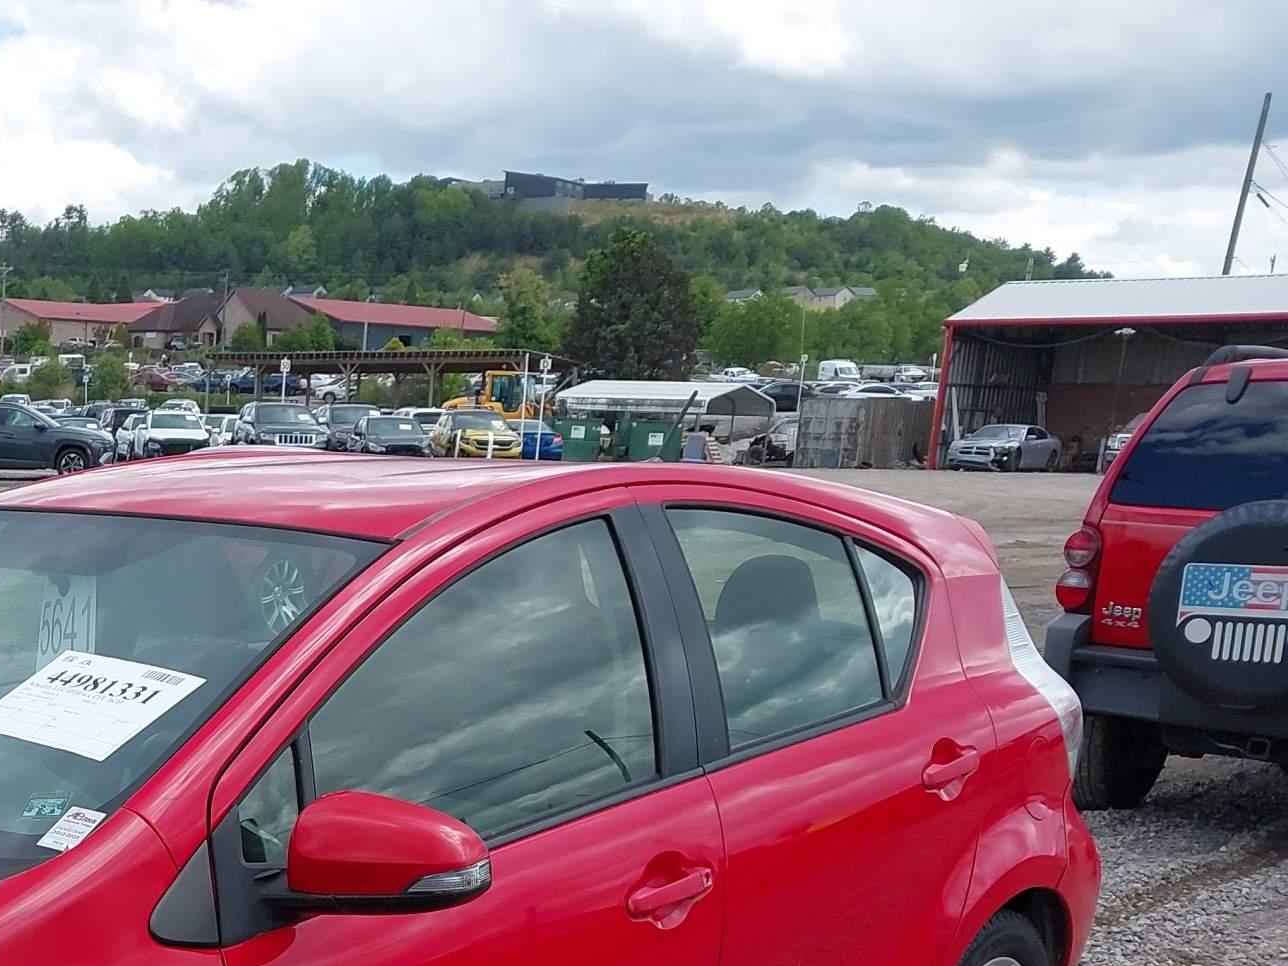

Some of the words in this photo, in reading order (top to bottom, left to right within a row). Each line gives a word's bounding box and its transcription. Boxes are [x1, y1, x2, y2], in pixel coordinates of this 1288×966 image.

[542, 360, 549, 369] D
[1102, 601, 1143, 621] Jeep
[40, 596, 91, 655] 5641
[47, 669, 164, 705] 44981331
